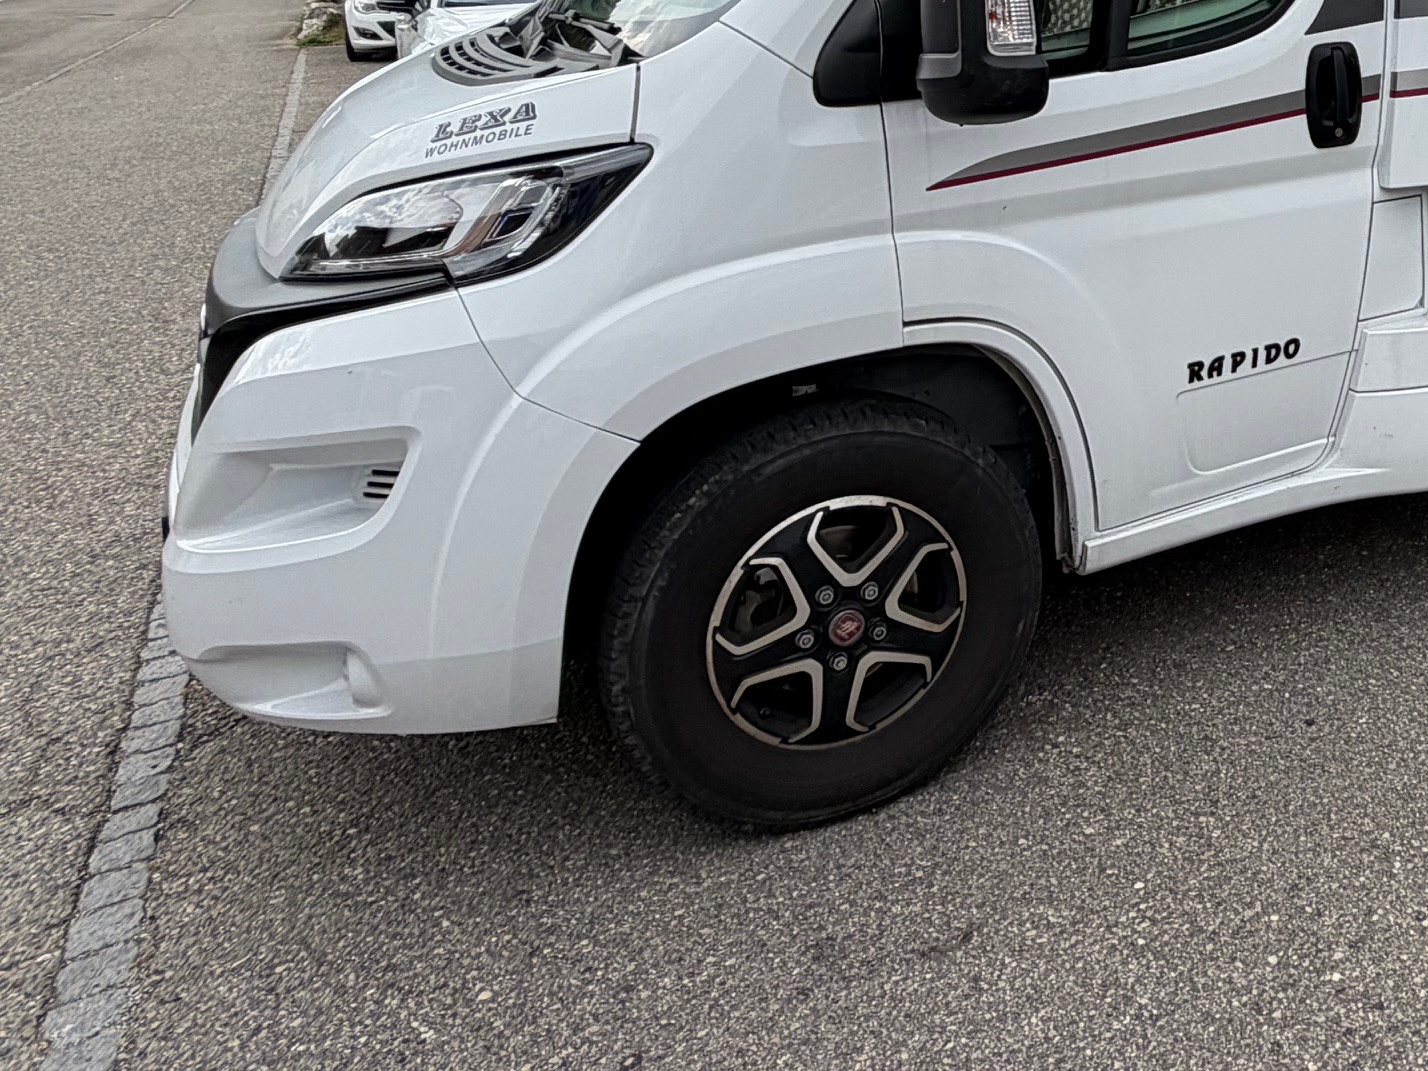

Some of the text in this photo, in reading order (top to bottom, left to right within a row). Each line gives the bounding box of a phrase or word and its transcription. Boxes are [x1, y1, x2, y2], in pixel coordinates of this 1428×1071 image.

[424, 123, 534, 159] WOHNMOBILE
[430, 102, 537, 143] LEXA
[1187, 337, 1301, 384] RAPIDO
